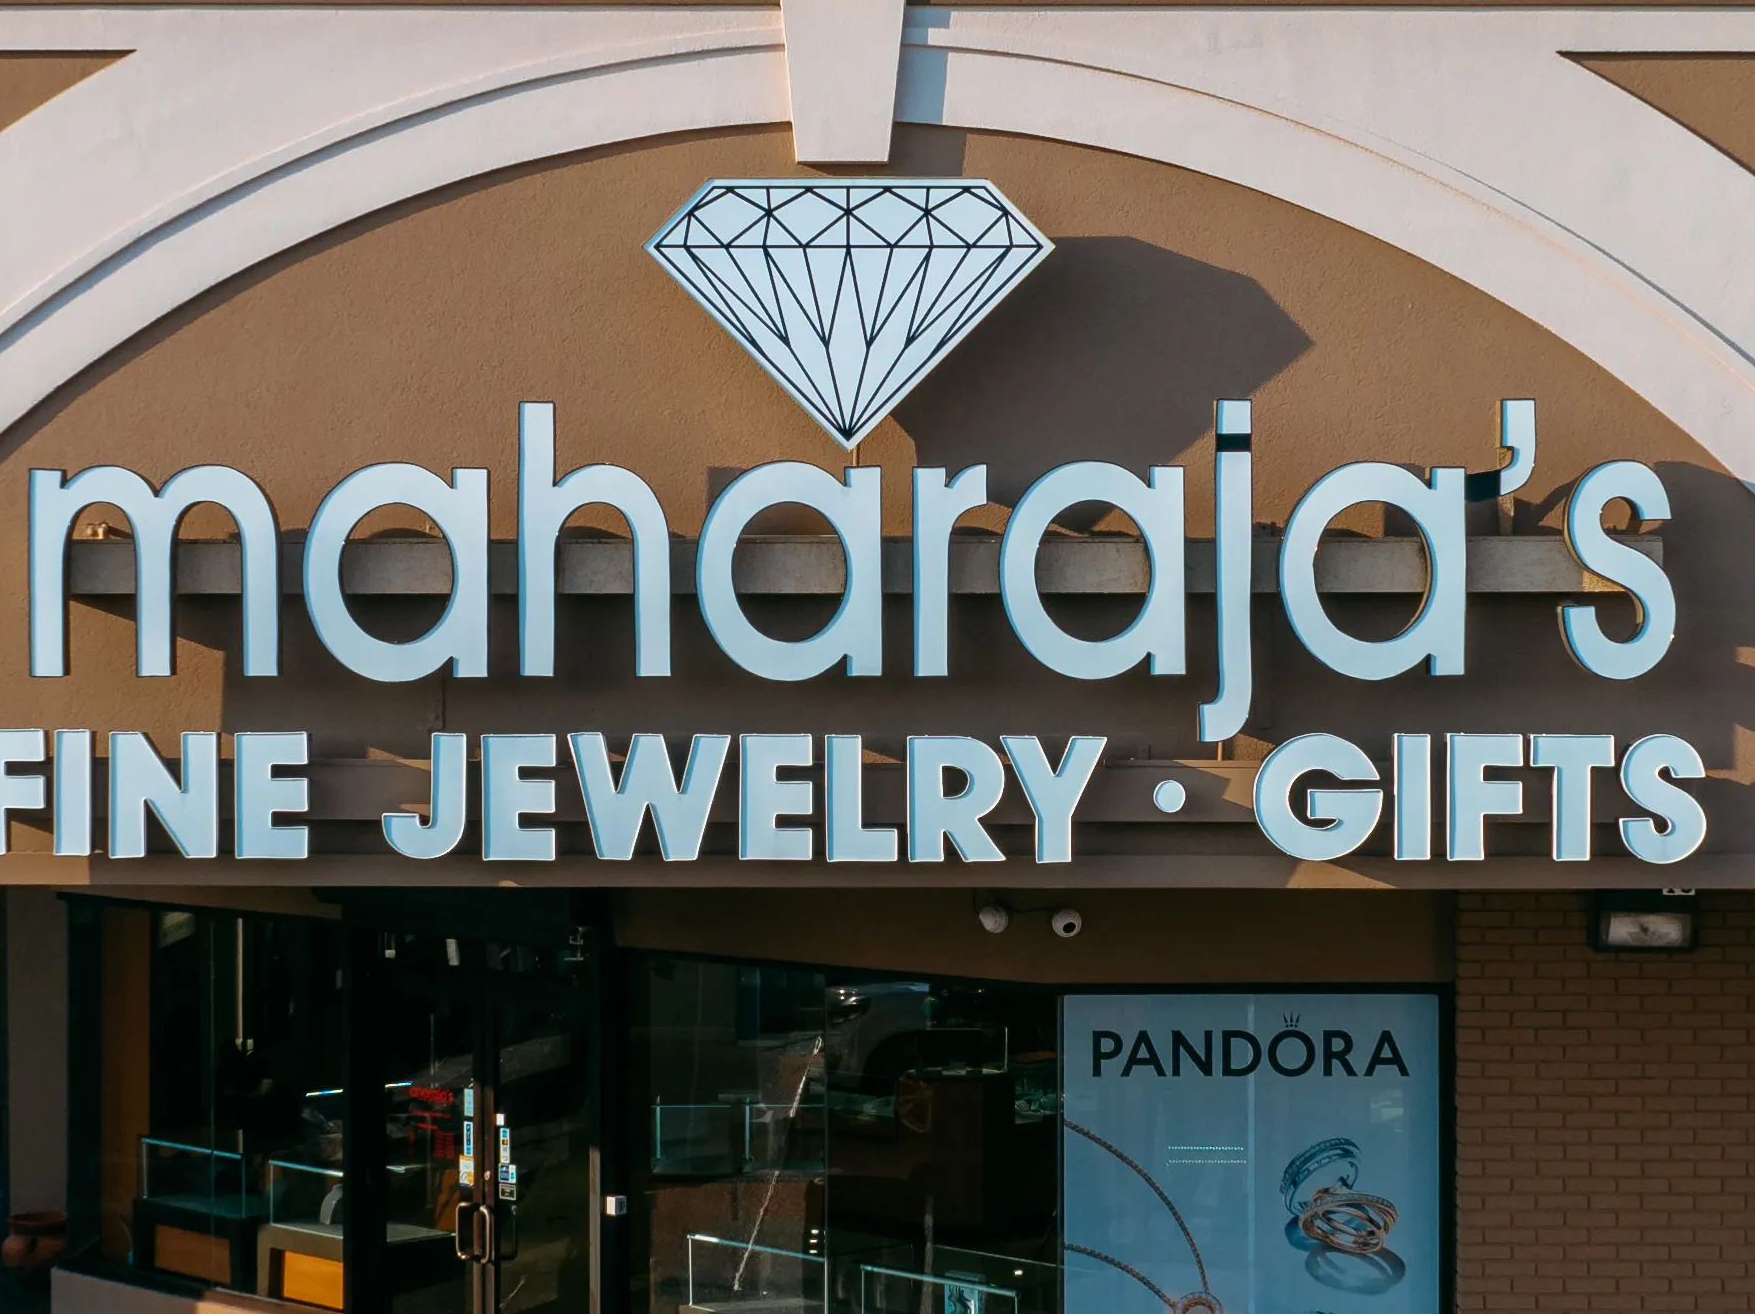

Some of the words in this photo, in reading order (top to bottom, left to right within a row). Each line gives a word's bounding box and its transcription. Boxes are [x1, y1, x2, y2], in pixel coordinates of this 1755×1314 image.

[29, 399, 1677, 742] maharaja's
[381, 731, 1106, 864] JEWELRY
[1253, 731, 1705, 864] GIFTS
[1091, 1028, 1410, 1078] PANDORA
